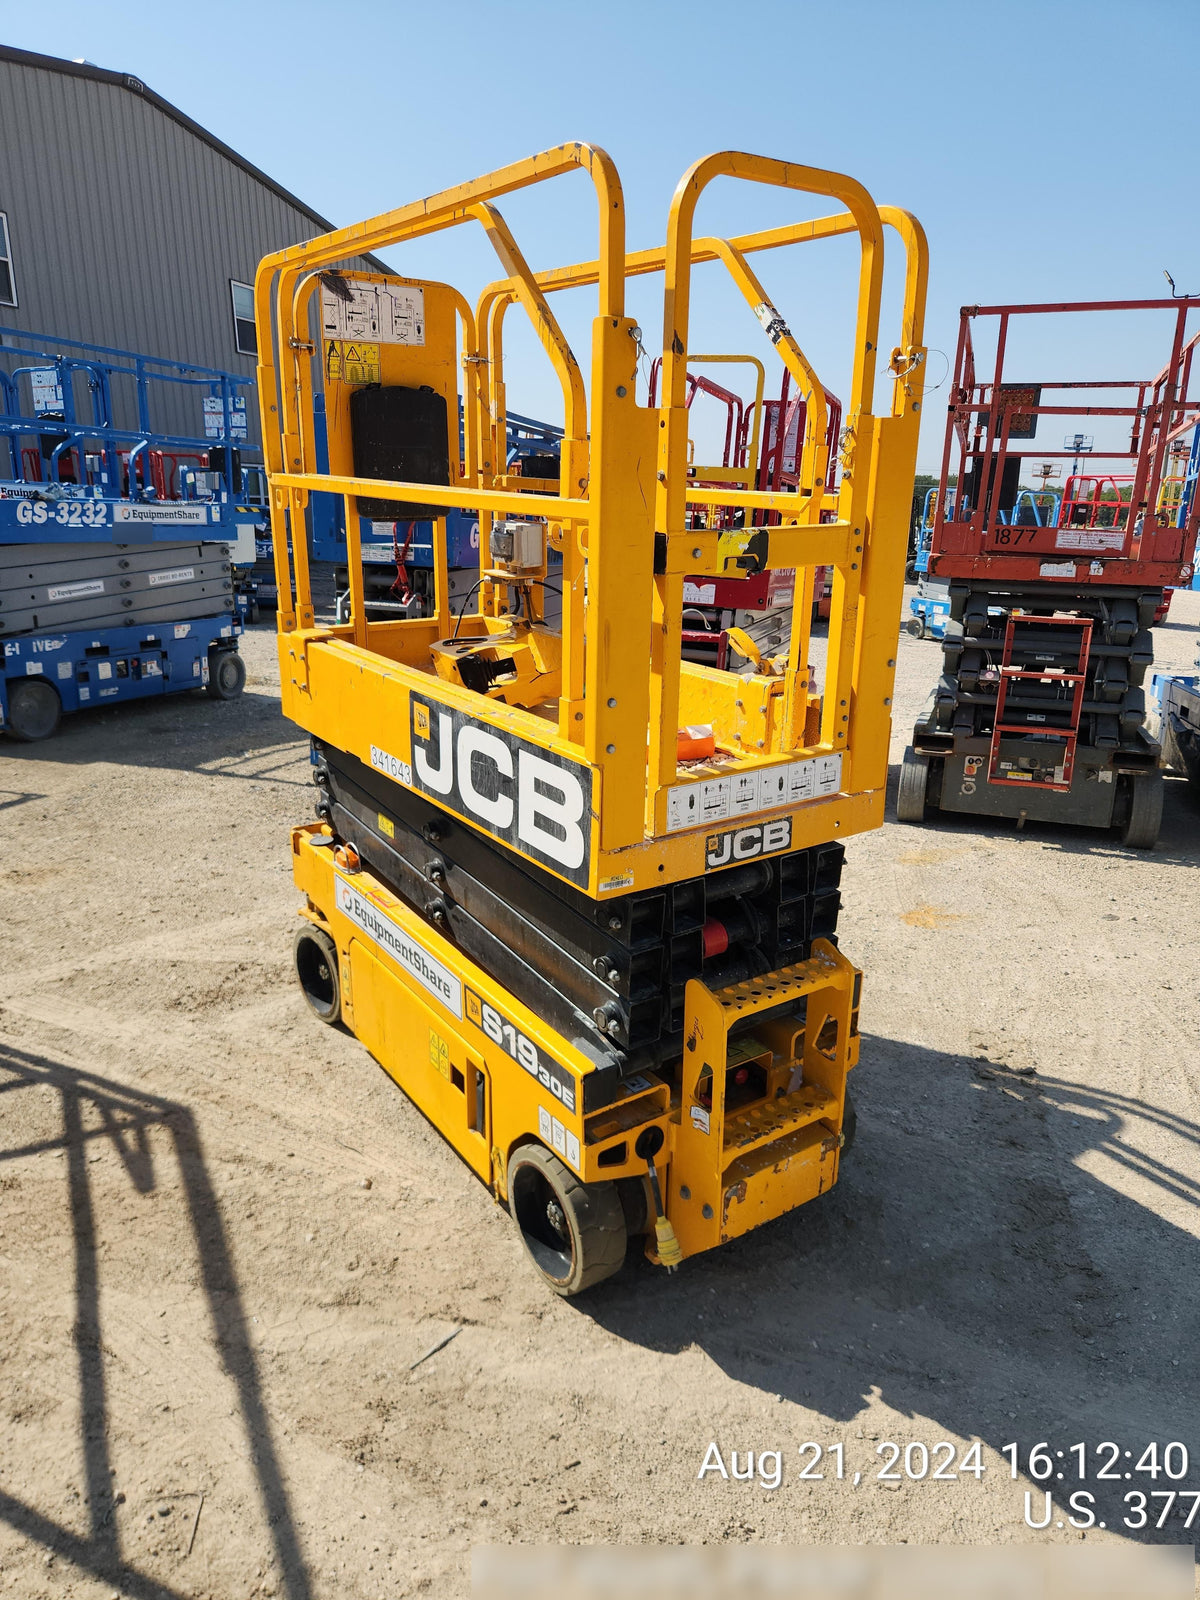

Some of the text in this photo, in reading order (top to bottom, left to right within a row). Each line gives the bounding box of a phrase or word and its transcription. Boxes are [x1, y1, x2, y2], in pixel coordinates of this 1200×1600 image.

[16, 501, 107, 524] GS-3232
[132, 509, 200, 520] EquipmentShare
[995, 528, 1038, 545] 1877
[371, 746, 412, 785] 341643
[414, 712, 585, 869] JCB
[707, 820, 790, 867] JCB
[354, 898, 452, 999] EquipmentShare
